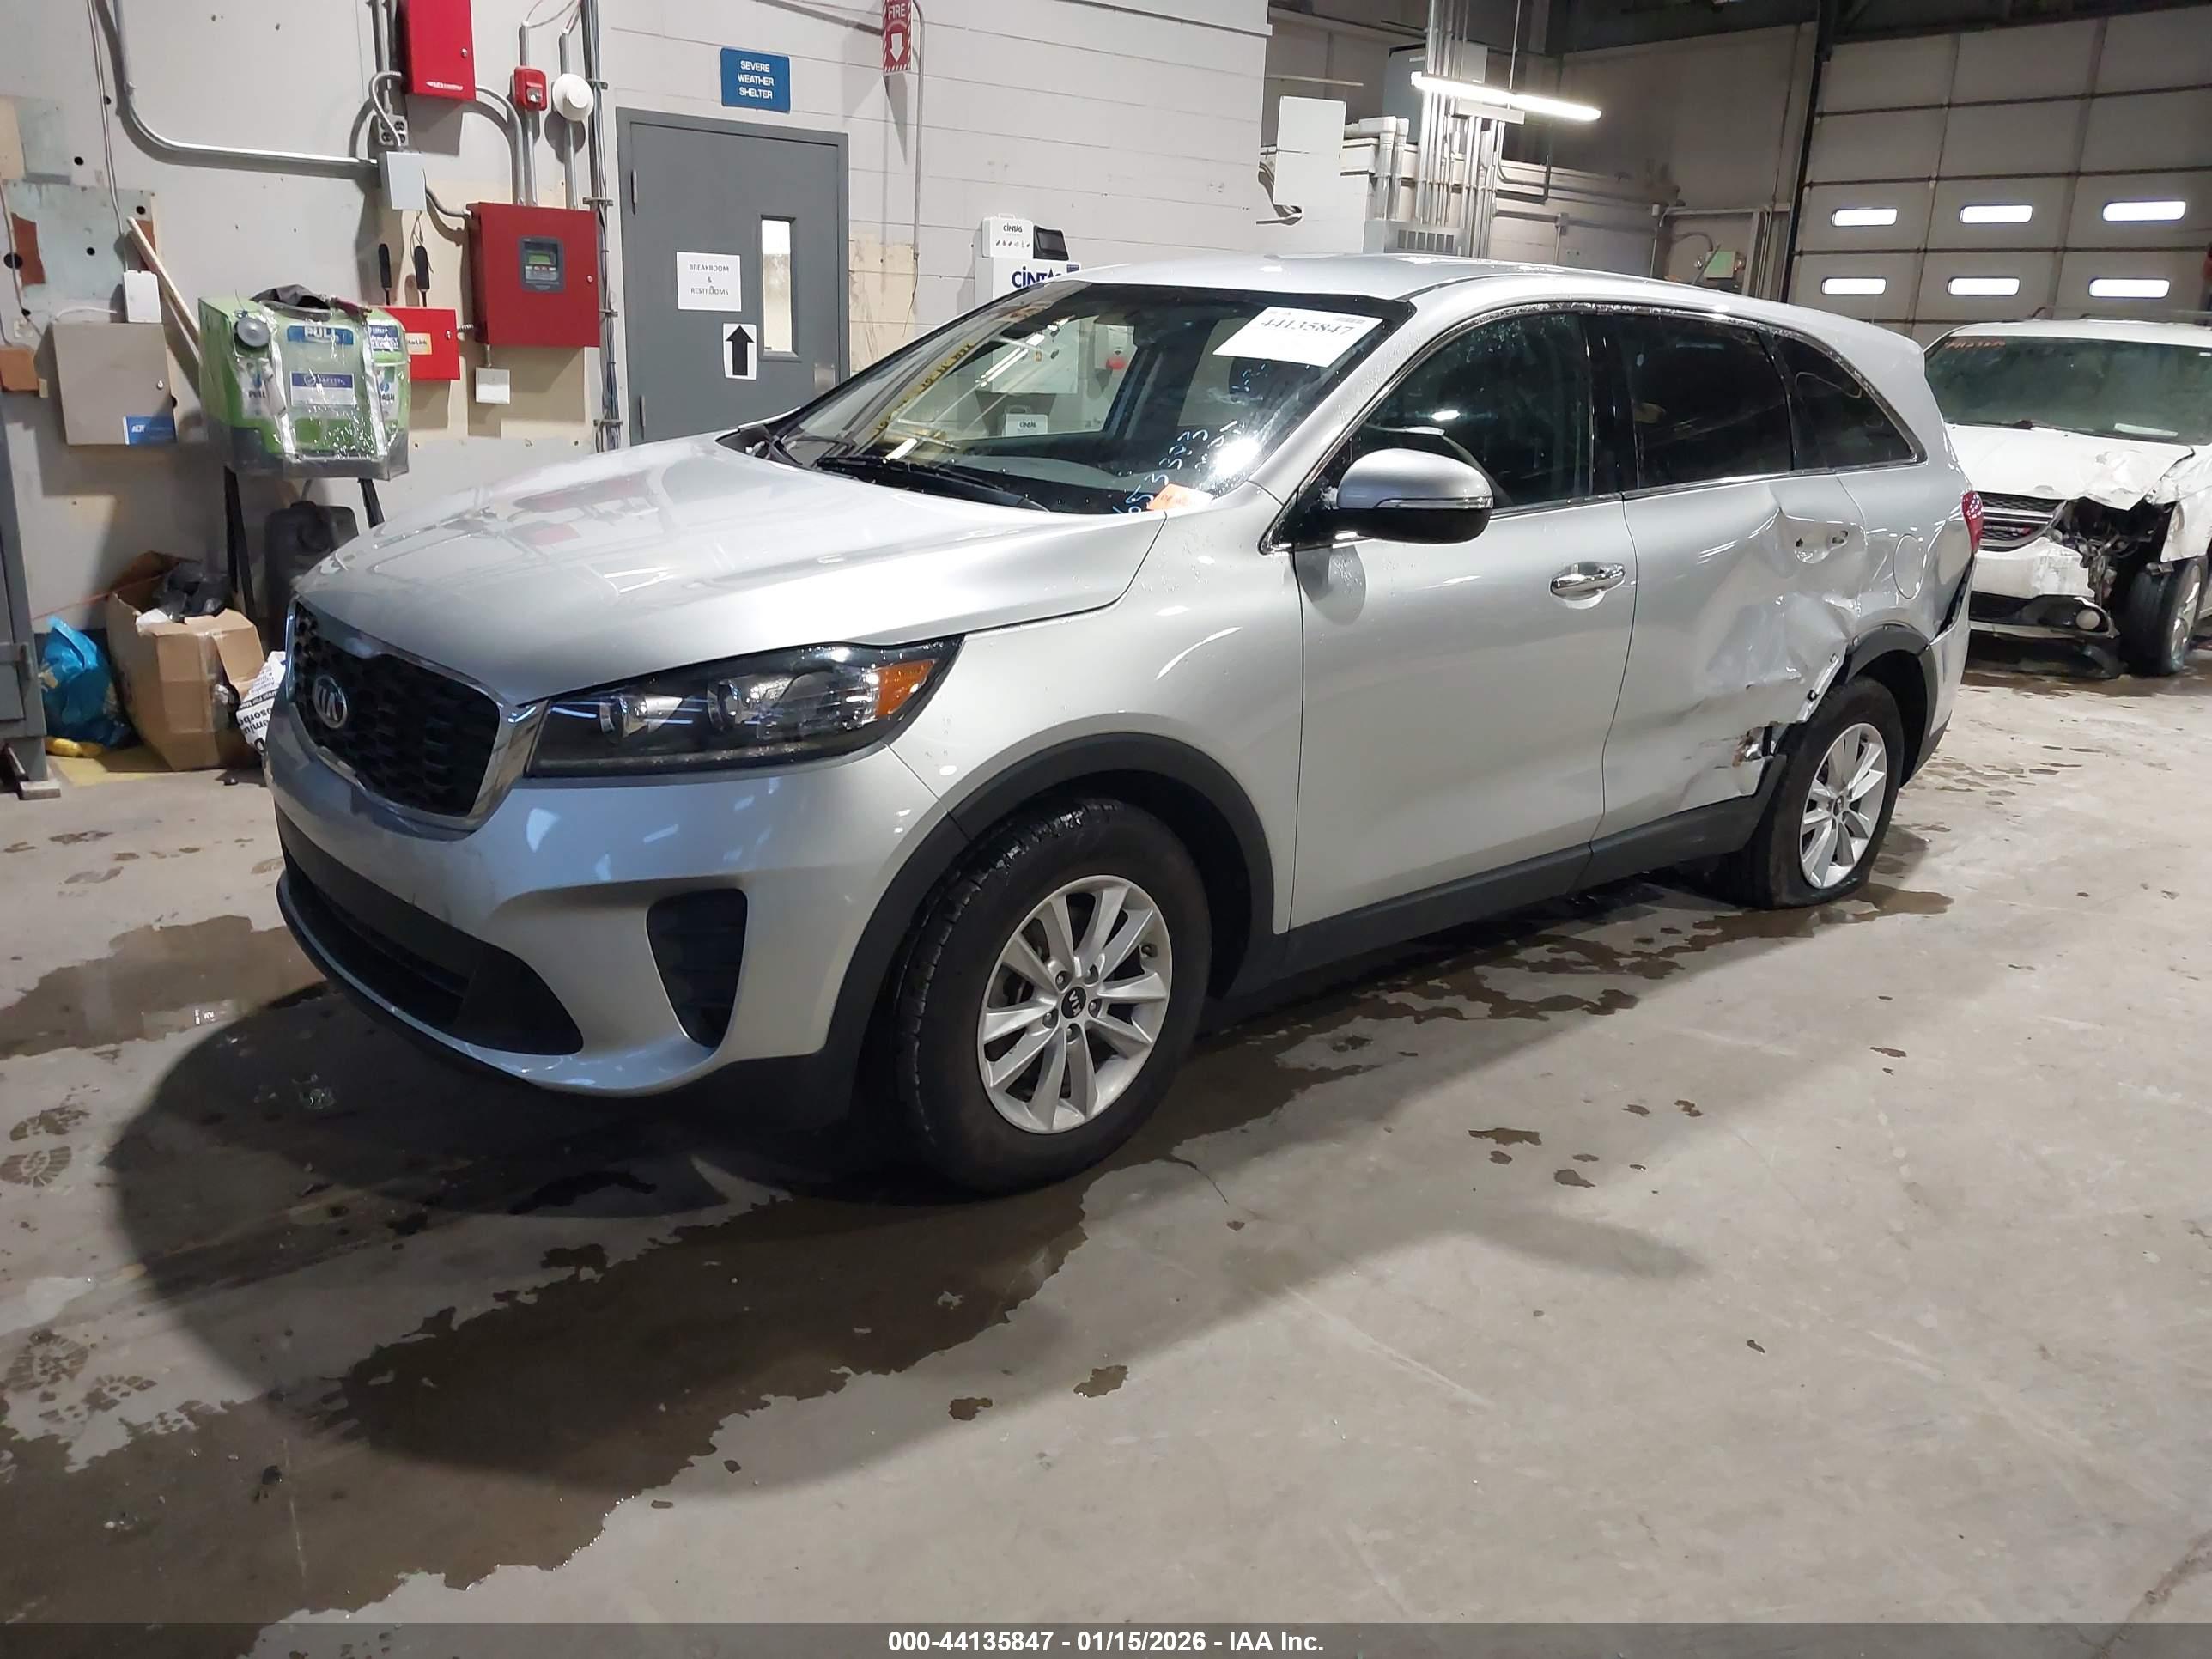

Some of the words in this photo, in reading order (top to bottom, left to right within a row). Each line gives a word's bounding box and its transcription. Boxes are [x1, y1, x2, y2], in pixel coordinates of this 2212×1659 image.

[888, 3, 906, 20] FIRE
[740, 60, 770, 73] SEVERE
[738, 74, 775, 86] WEATHER
[739, 87, 773, 99] SHELTER
[690, 264, 729, 272] BREAKROOM
[691, 287, 729, 295] RESTROOMS
[1261, 318, 1355, 335] 44135847
